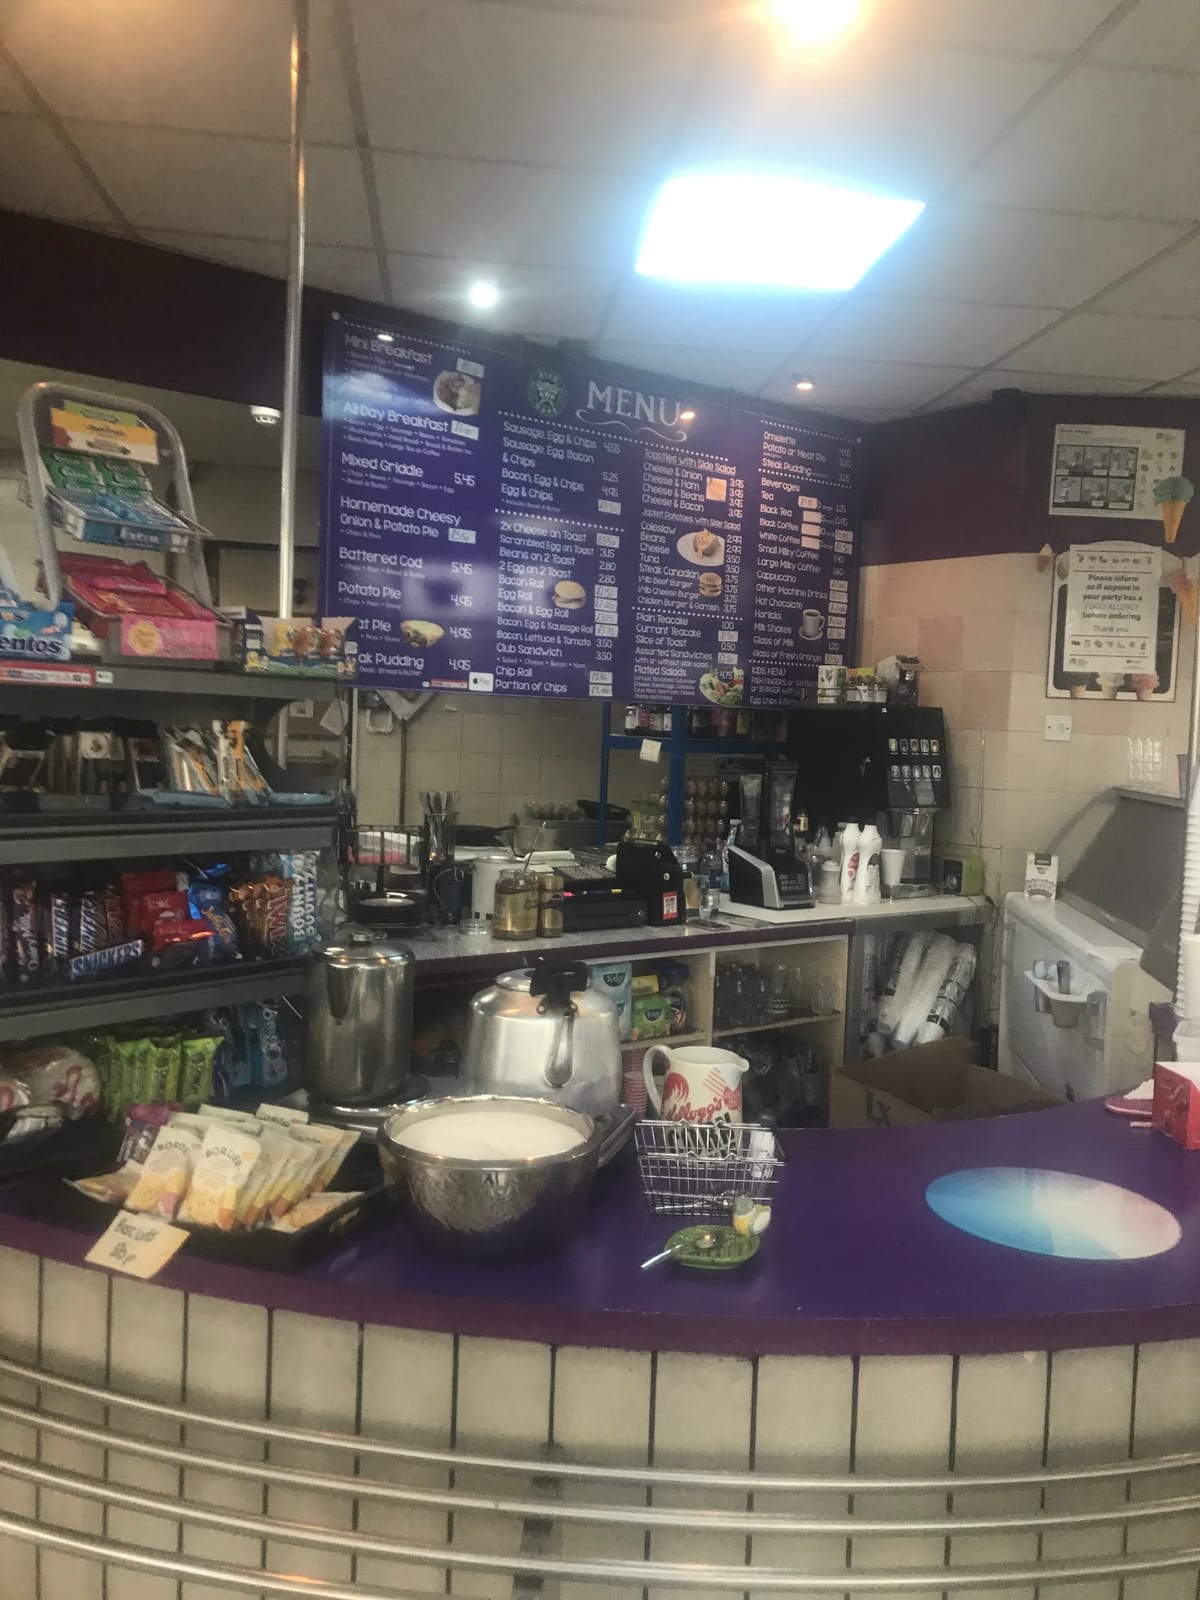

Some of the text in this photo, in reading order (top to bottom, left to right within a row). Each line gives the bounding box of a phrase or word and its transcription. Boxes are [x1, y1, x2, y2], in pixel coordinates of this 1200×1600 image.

[370, 340, 432, 365] Breakfast
[586, 380, 681, 427] MENU
[360, 404, 385, 422] Day
[387, 409, 449, 432] Breakfast
[547, 430, 597, 449] Egg Chips
[763, 431, 797, 446] Omelette
[566, 450, 594, 463] Bacon
[763, 441, 787, 455] Potato
[797, 449, 815, 460] Meat
[510, 453, 536, 468] Chips
[644, 449, 736, 476] Toasties Side Salad
[762, 457, 812, 477] Steak Pudding
[341, 451, 378, 470] Mixed
[380, 459, 424, 477] Griddle
[453, 471, 476, 487] 5.45
[642, 462, 703, 481] Cheese Onion
[533, 473, 585, 492] Egg Chips
[642, 472, 700, 490] Cheese Ham
[761, 477, 801, 492] Beverages
[501, 483, 554, 502] Egg Chips
[642, 483, 705, 502] Cheese Beans
[761, 490, 774, 501] Tea
[340, 495, 461, 527] Homemade Cheesy
[641, 493, 704, 513] Cheese Bacon
[760, 503, 792, 517] Black Tea
[340, 512, 372, 529] Onion
[383, 519, 421, 535] Potato
[422, 524, 440, 538] Pie
[640, 520, 676, 535] Coleslaw
[759, 517, 800, 531] Black Coffee
[513, 522, 548, 537] Cheese
[563, 530, 587, 543] Toast
[640, 531, 666, 544] Beans
[778, 534, 801, 545] Coffee
[500, 534, 594, 556] Scrambled Egg Toast
[640, 542, 670, 555] Cheese
[758, 543, 820, 560] Small Milky Coffee
[339, 546, 473, 575] Battered Cod 5.45
[499, 546, 576, 566] Beans on Toast
[640, 553, 660, 564] Tuna
[507, 561, 572, 579] Egg on Toast
[639, 563, 700, 579] Steak Canadian
[757, 557, 821, 573] Large Milky Coffee
[498, 574, 545, 589] Bacon Roll
[670, 578, 693, 589] Burger
[756, 570, 797, 583] Cappuccino
[338, 581, 381, 598] Potato
[382, 586, 402, 600] Pie
[498, 588, 533, 601] Egg Roll
[652, 585, 701, 601] Cheese Burger
[755, 583, 806, 597] Other Machine
[497, 601, 569, 618] Bacon Egg Roll
[637, 595, 720, 612] Chicken Burger Garnish
[769, 597, 803, 609] Chocolate
[636, 612, 689, 626] Plain Teacake
[754, 609, 782, 620] Horlicks
[1108, 611, 1141, 621] ordering
[372, 619, 391, 632] Pie
[524, 619, 594, 634] Egg Sausage Roll
[636, 624, 702, 638] Currant Teacake
[767, 624, 792, 634] Shakes
[0, 635, 62, 654] entos
[525, 633, 591, 647] Lettuce Tomato
[636, 635, 687, 648] Slice Toast
[753, 636, 772, 645] Glass
[496, 643, 563, 657] Club Sandwich
[635, 647, 669, 657] Assorted
[670, 649, 713, 660] Sandwiches
[376, 652, 424, 670] Pudding
[495, 665, 533, 678] Chip Roll
[634, 664, 687, 677] Plated Salads
[495, 679, 568, 694] Portion Chips
[291, 868, 306, 941] BOUNTY
[304, 868, 316, 938] BOUNTY
[73, 940, 141, 976] SNICKERS
[667, 1097, 723, 1124] Kellogg's
